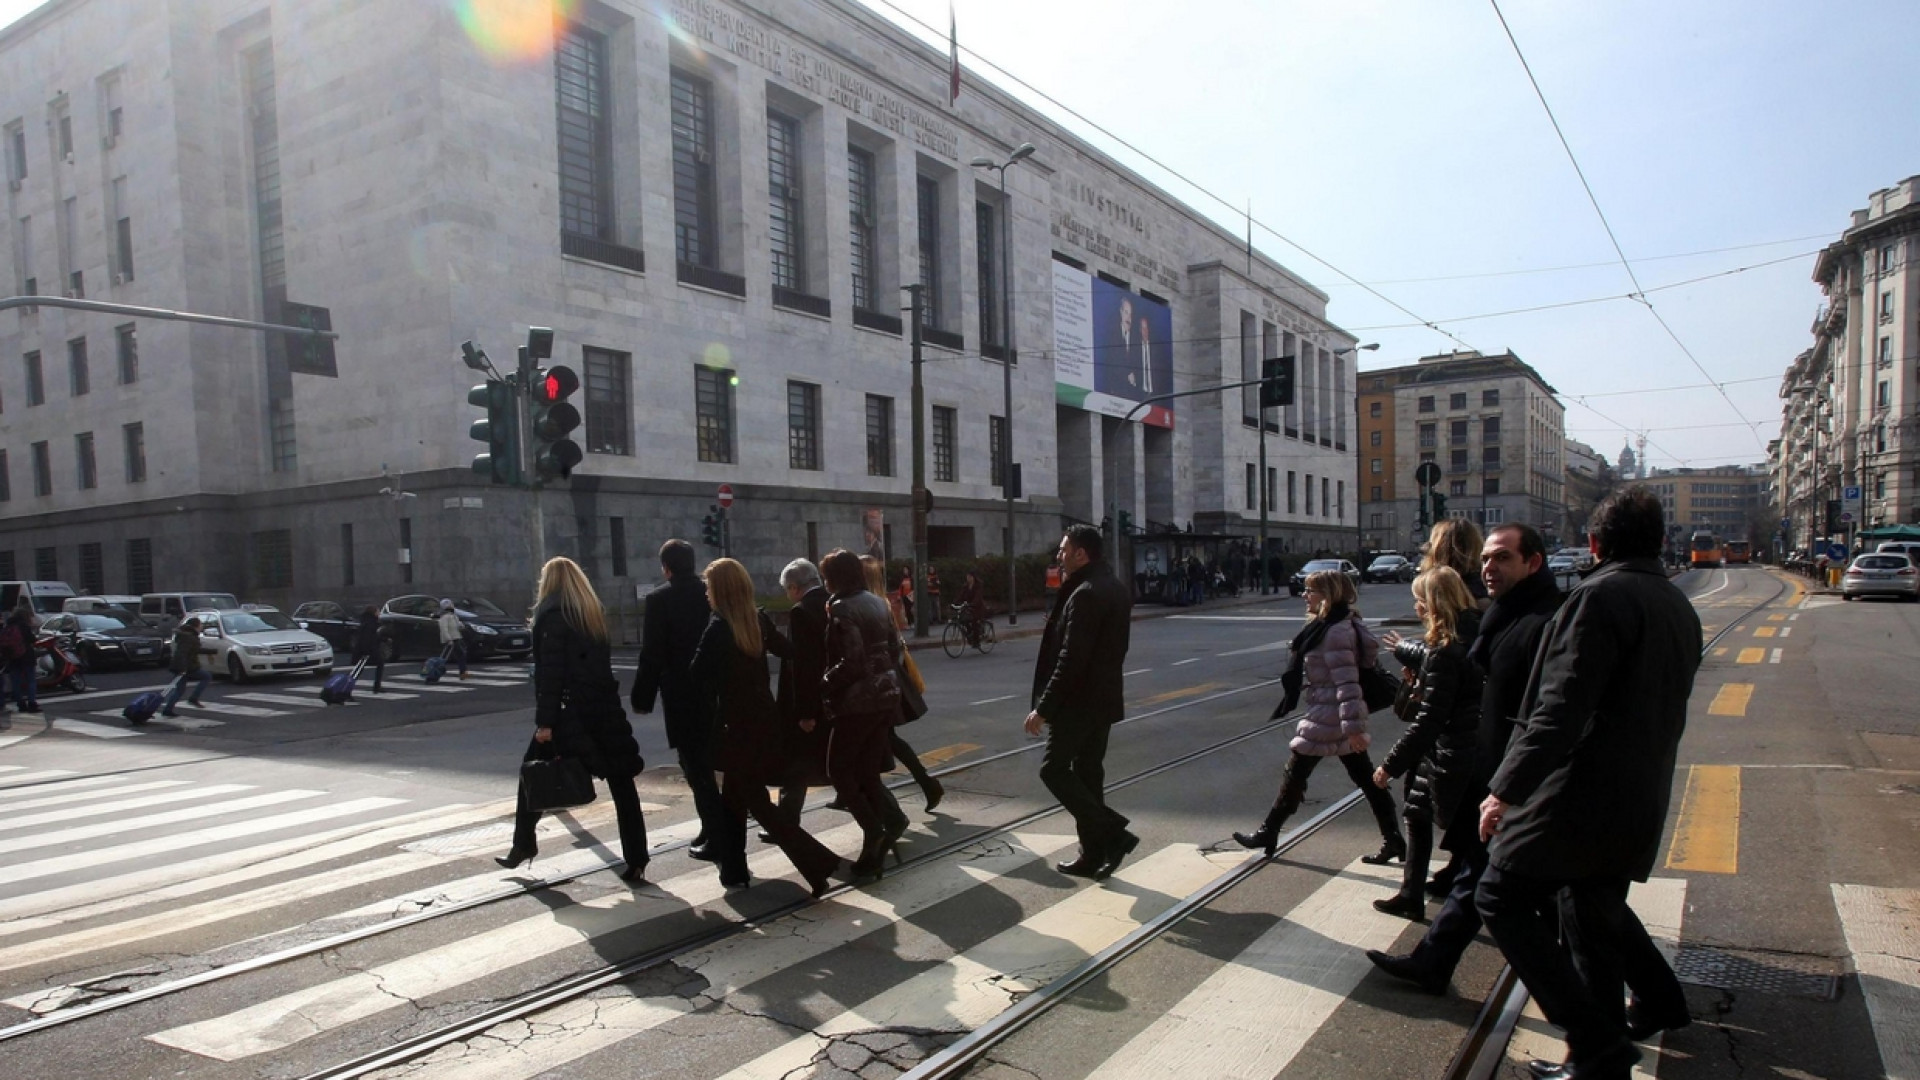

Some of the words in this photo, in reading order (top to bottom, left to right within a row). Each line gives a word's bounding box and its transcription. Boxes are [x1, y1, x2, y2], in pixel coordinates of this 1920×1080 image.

[672, 0, 782, 56] RISPRVDENTIA
[788, 45, 807, 70] EST
[1848, 489, 1856, 497] P
